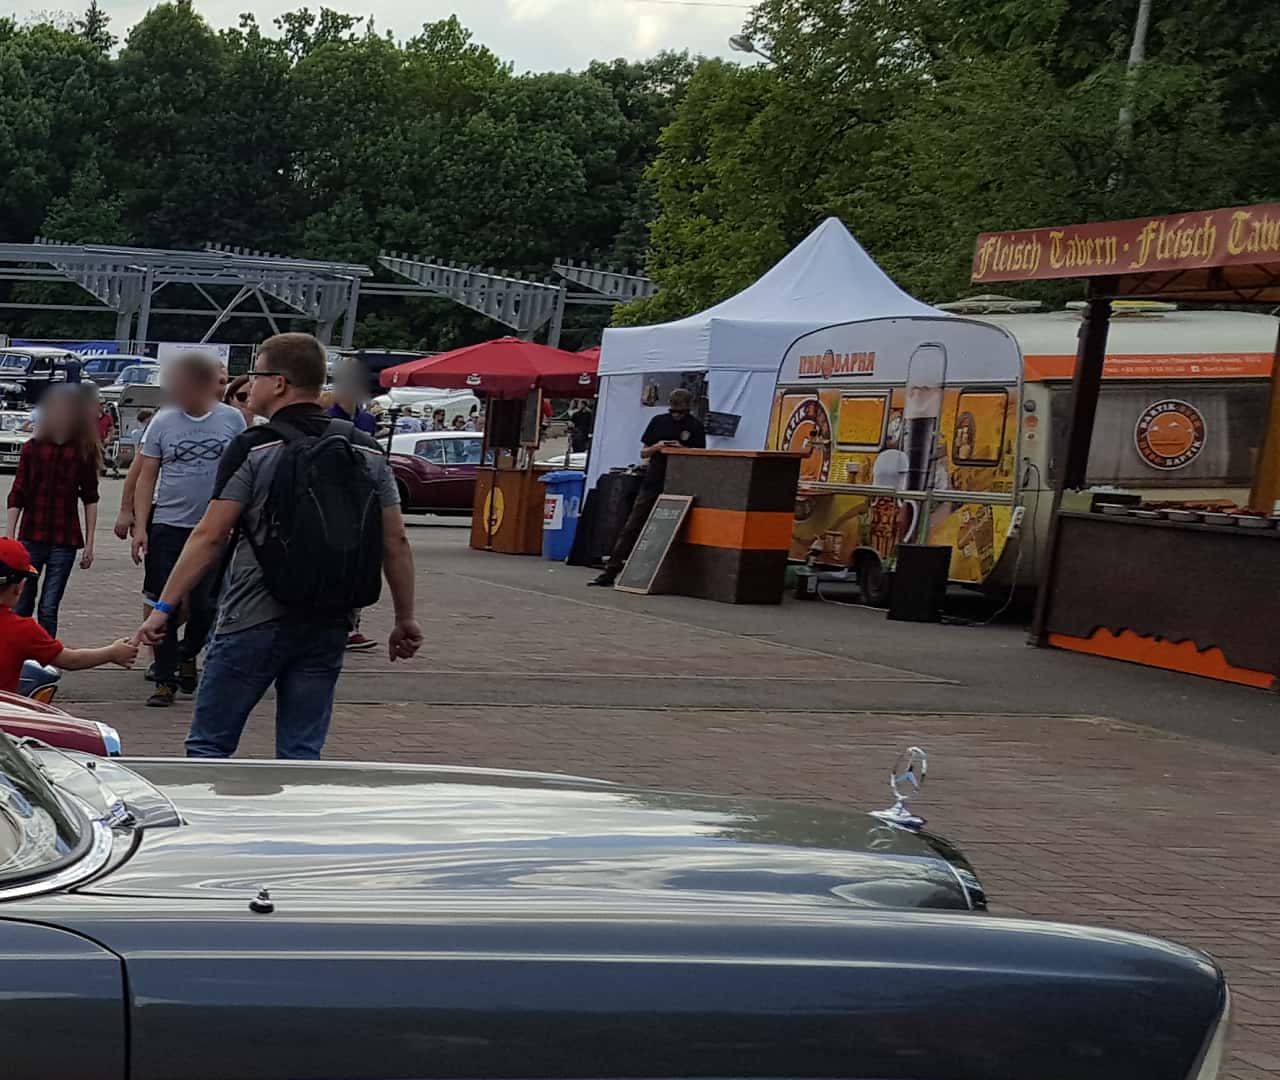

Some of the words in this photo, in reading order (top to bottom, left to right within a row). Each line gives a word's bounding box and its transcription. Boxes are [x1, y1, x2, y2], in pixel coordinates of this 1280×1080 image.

[972, 233, 1040, 279] Fleisch
[1049, 231, 1117, 269] Tavern
[1130, 215, 1217, 269] Fleisch
